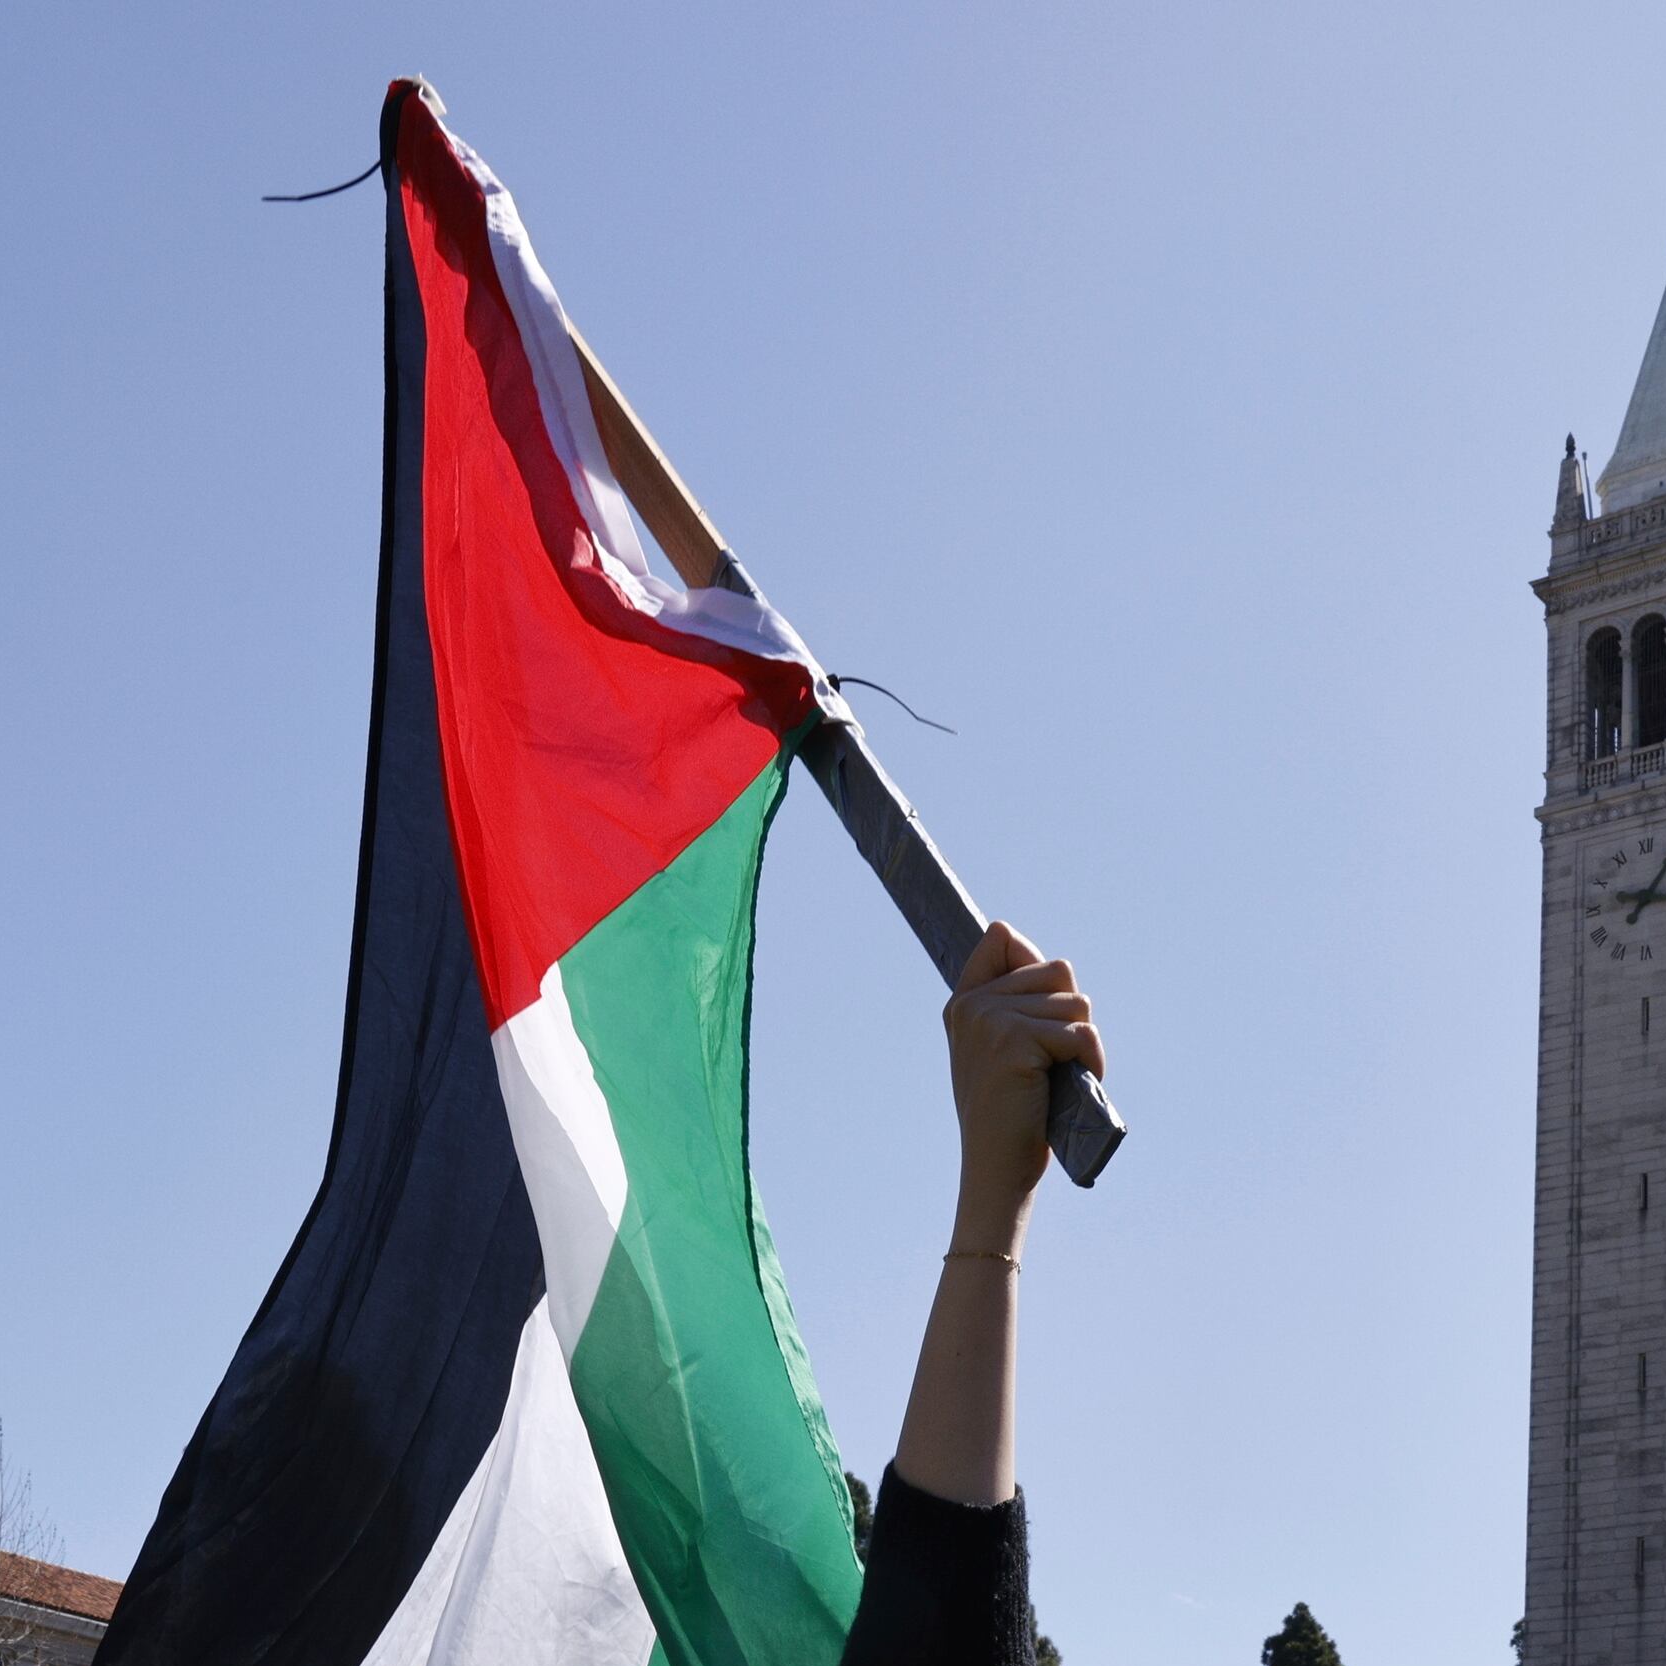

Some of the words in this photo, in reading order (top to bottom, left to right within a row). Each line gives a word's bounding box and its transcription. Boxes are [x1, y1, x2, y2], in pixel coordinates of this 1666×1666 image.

[1638, 837, 1654, 855] XII
[1612, 850, 1628, 869] XI
[1593, 878, 1608, 889] X
[1640, 944, 1653, 961] VI
